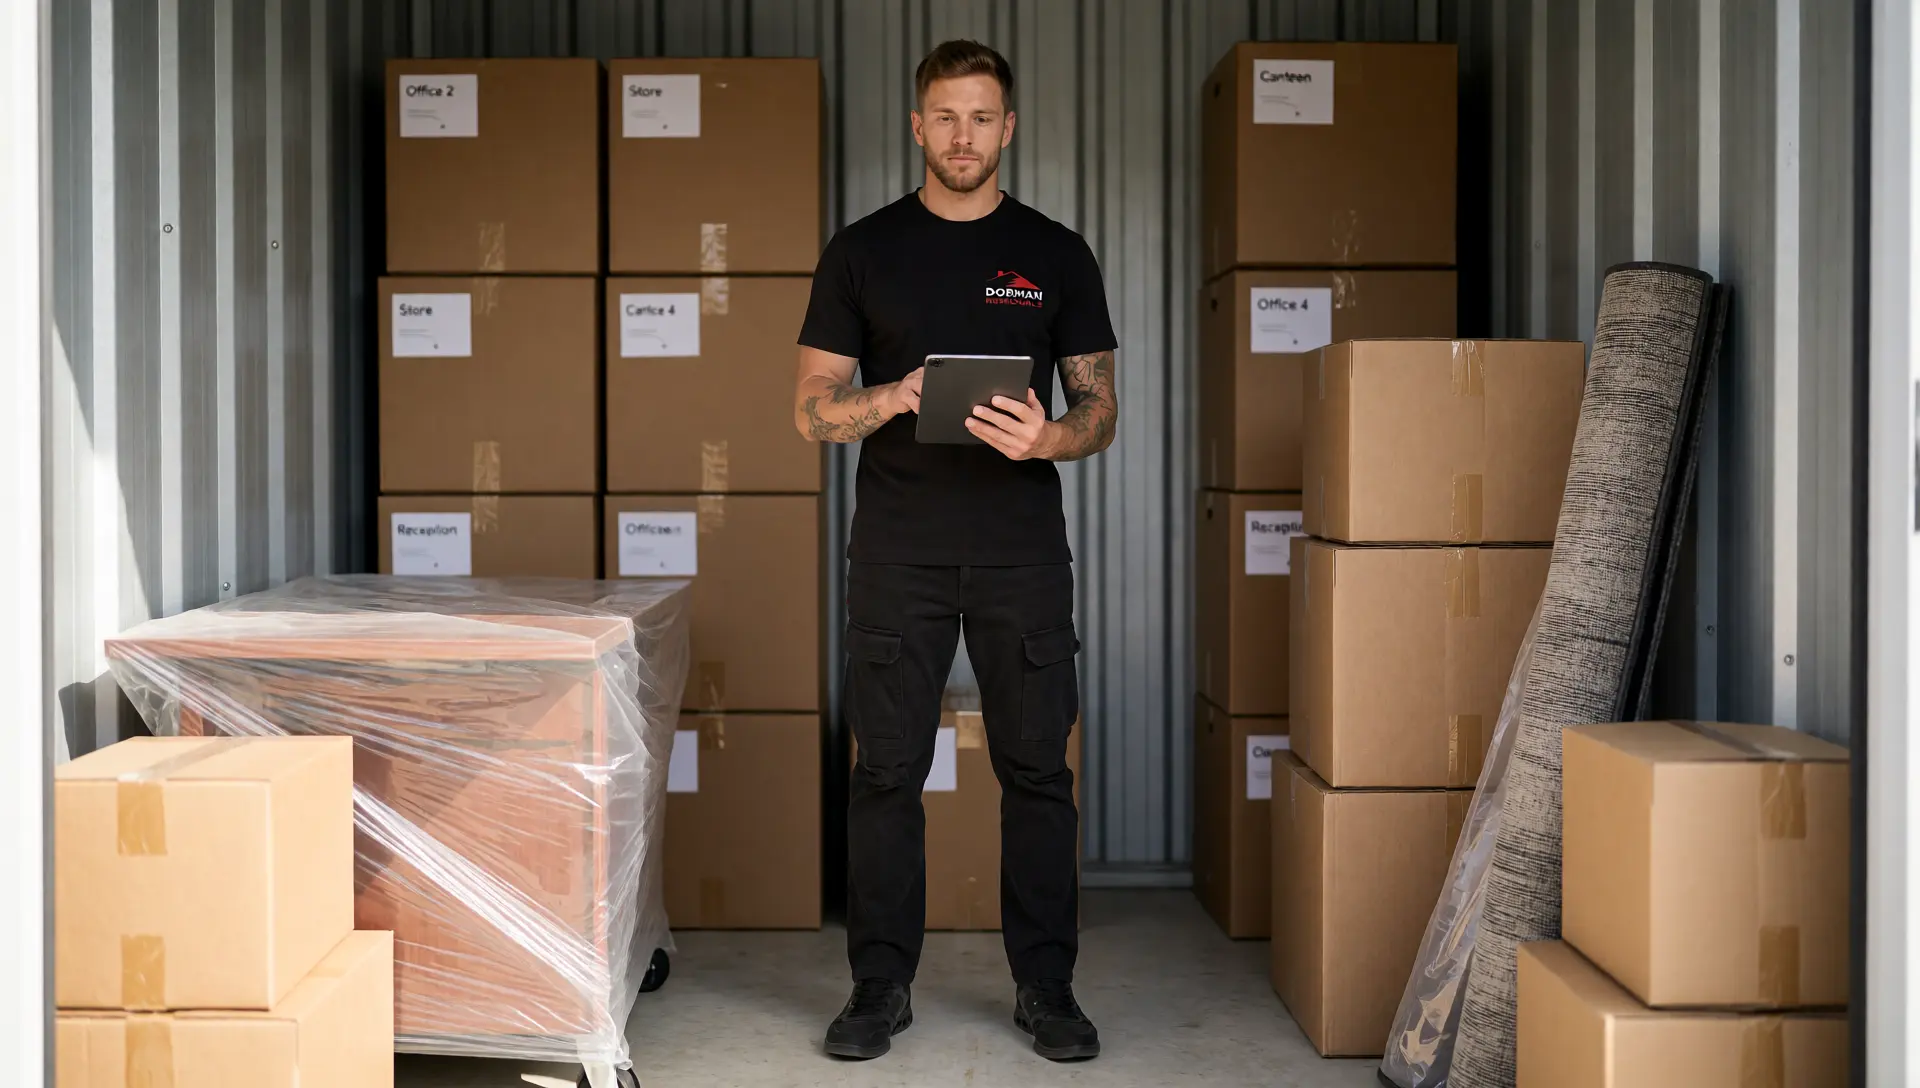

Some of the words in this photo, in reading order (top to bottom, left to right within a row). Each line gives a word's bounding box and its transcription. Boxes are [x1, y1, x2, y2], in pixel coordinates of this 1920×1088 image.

[405, 84, 443, 97] Office
[446, 84, 455, 97] 2
[629, 84, 662, 97] Store
[399, 303, 433, 316] Store
[668, 304, 676, 315] 4
[1257, 298, 1297, 311] Office
[1301, 298, 1308, 311] 4
